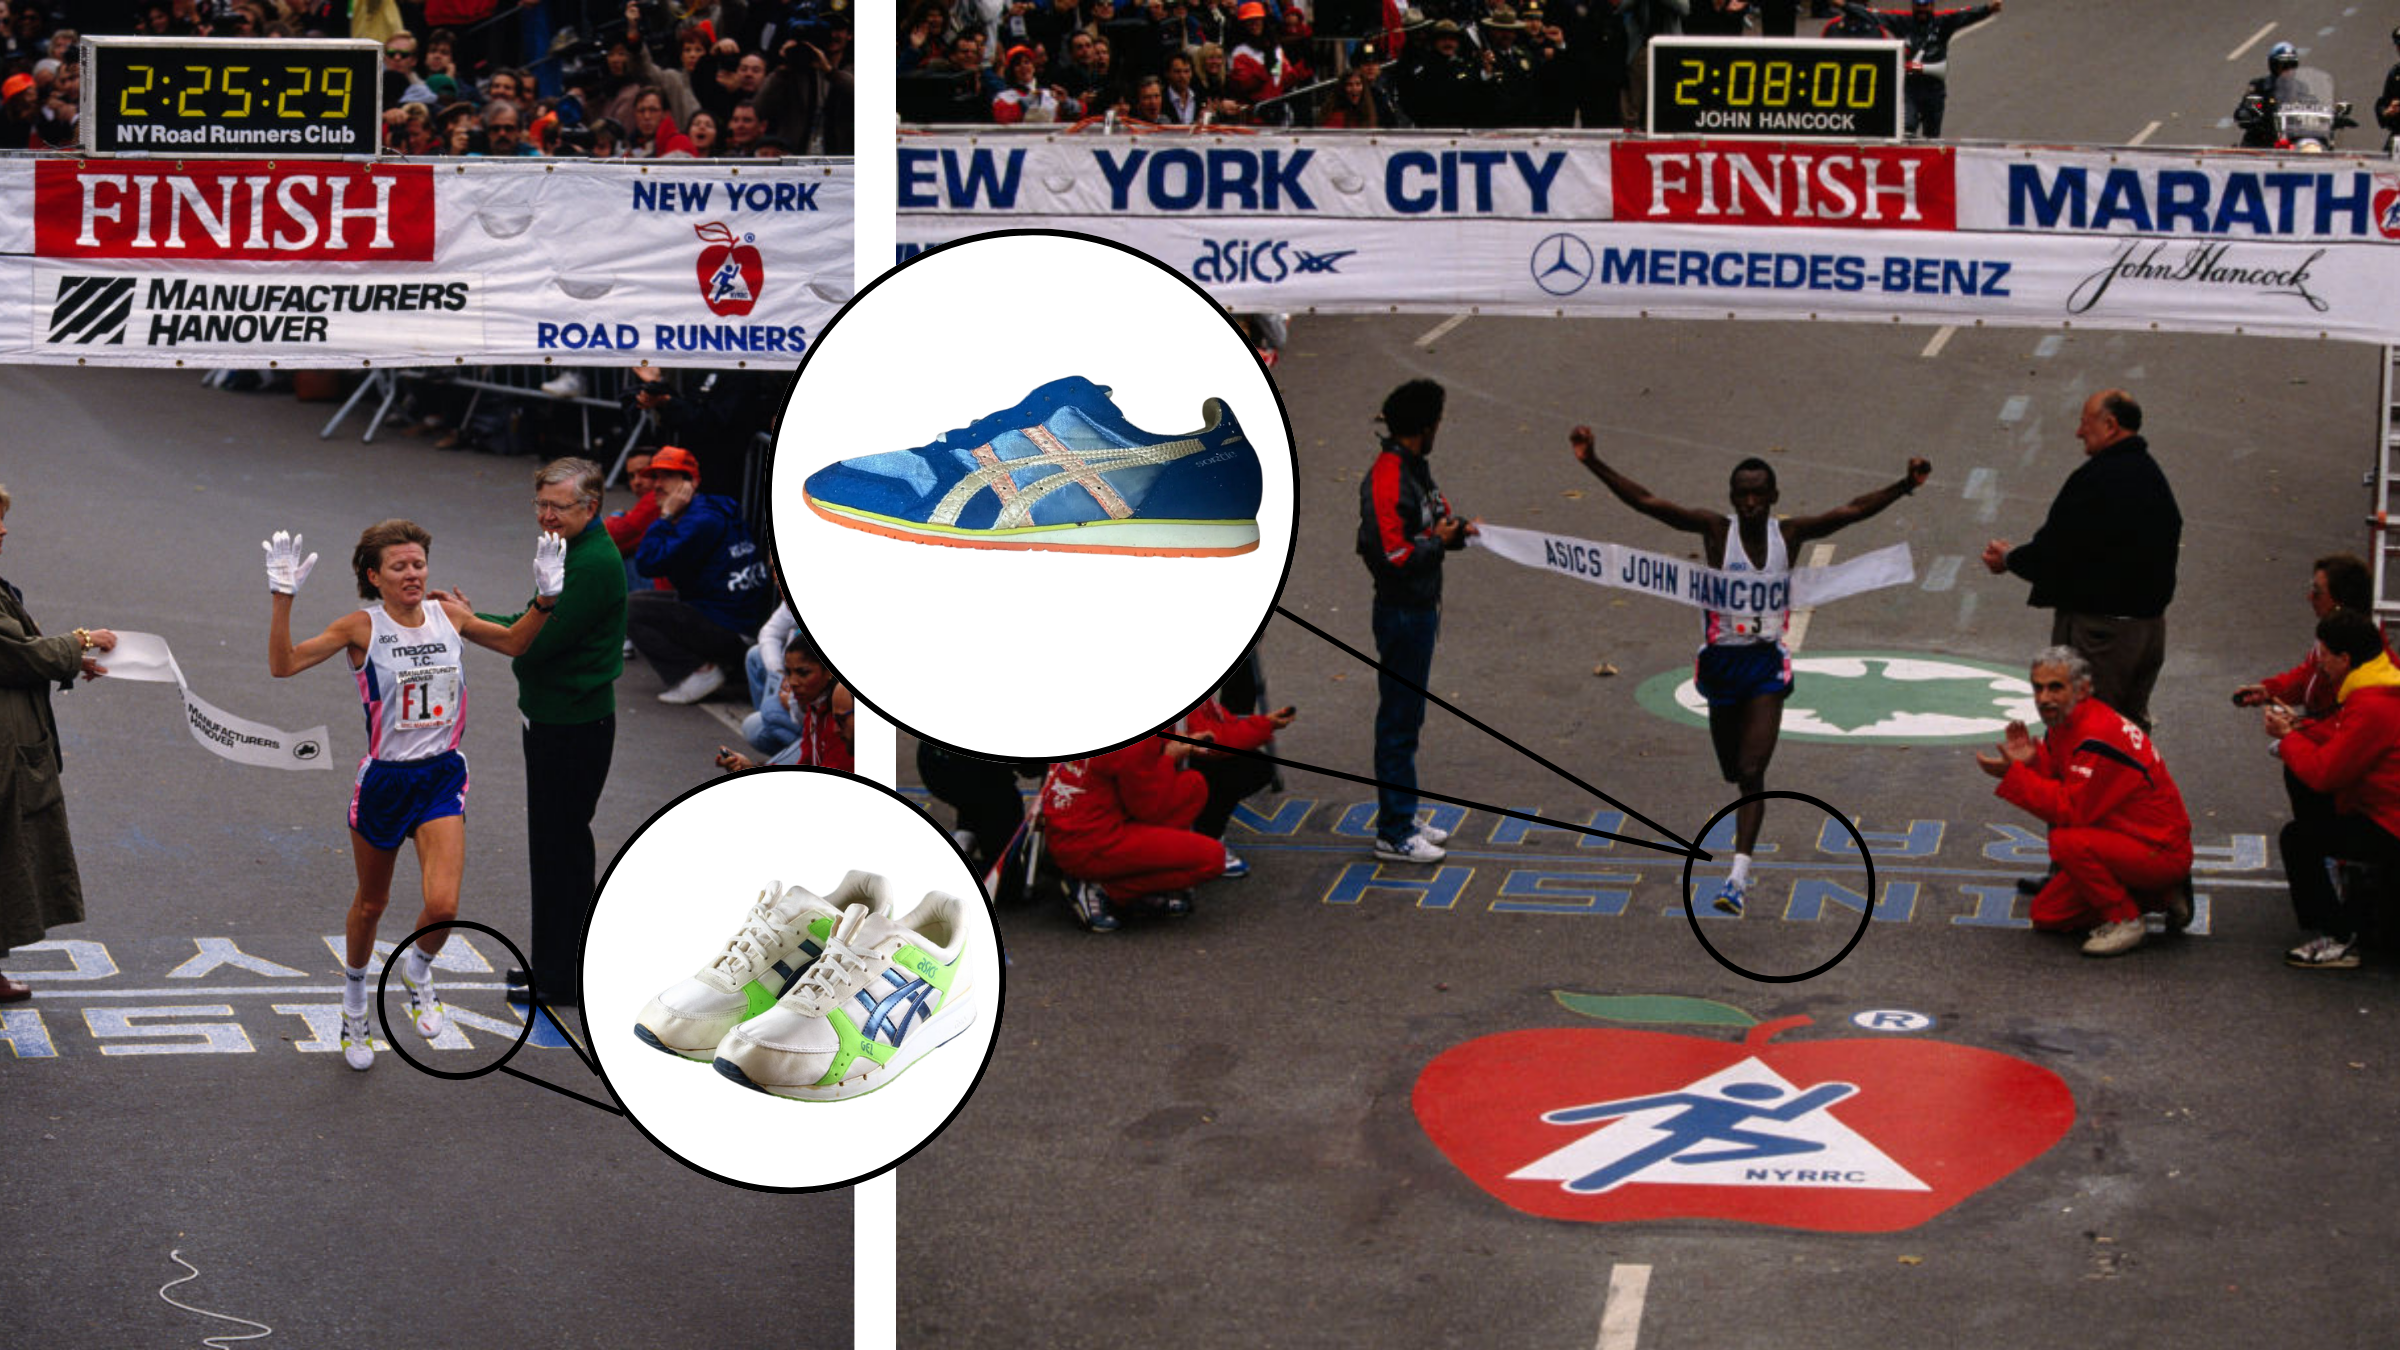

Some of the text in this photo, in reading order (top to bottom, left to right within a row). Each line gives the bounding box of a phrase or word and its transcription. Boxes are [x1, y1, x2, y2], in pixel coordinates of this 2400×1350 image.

[119, 65, 353, 118] 2:25:29
[1675, 60, 1878, 108] 2:08:00
[117, 125, 356, 144] NY Road Runners Club
[1695, 110, 1855, 130] JOHN HANCOCK
[632, 180, 822, 212] NEW YORK
[1093, 147, 1317, 211] YORK
[1385, 150, 1568, 214] CITY
[1645, 150, 1923, 221] FINISH
[75, 173, 397, 251] FINISH
[1192, 238, 1289, 284] asics
[1602, 247, 2012, 297] MERCEDES-BENZ
[2066, 239, 2330, 315] John Hancock
[146, 278, 470, 313] MANUFACTURERS
[148, 314, 329, 347] HANOVER
[537, 322, 807, 353] ROAD RUNNERS
[1545, 539, 1602, 577] ASICS
[1621, 553, 1678, 595] JOHN
[411, 656, 434, 667] T.C.
[188, 703, 281, 750] MANUFACTURERS
[190, 715, 235, 749] HANOVER
[860, 1039, 875, 1057] GEL
[1744, 1168, 1867, 1184] NYRRC
